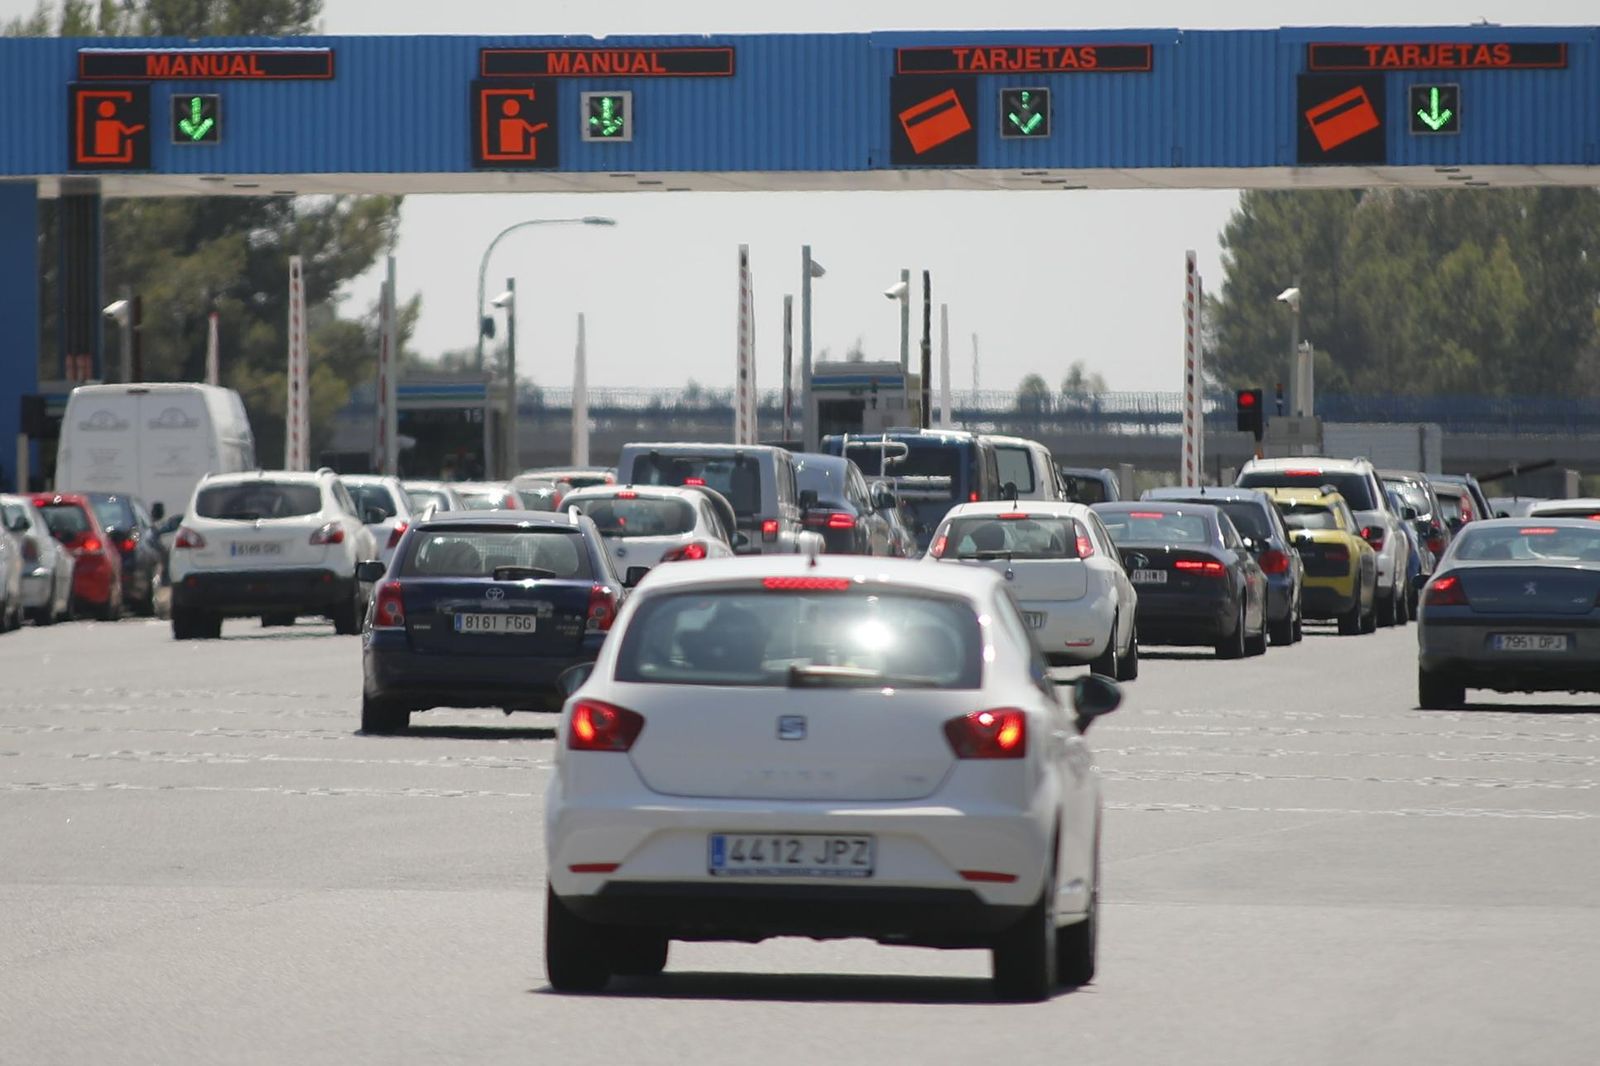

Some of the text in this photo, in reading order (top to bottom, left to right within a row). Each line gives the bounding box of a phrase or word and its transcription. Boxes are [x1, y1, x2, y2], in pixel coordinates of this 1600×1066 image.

[146, 54, 265, 76] MANUAL
[547, 52, 666, 74] MANUAL
[952, 47, 1096, 69] TARJETAS
[1365, 45, 1510, 67] TARJETAS
[465, 615, 532, 631] 8161 FGG
[1505, 636, 1534, 649] 7951
[730, 839, 867, 866] 4412 JPZ
